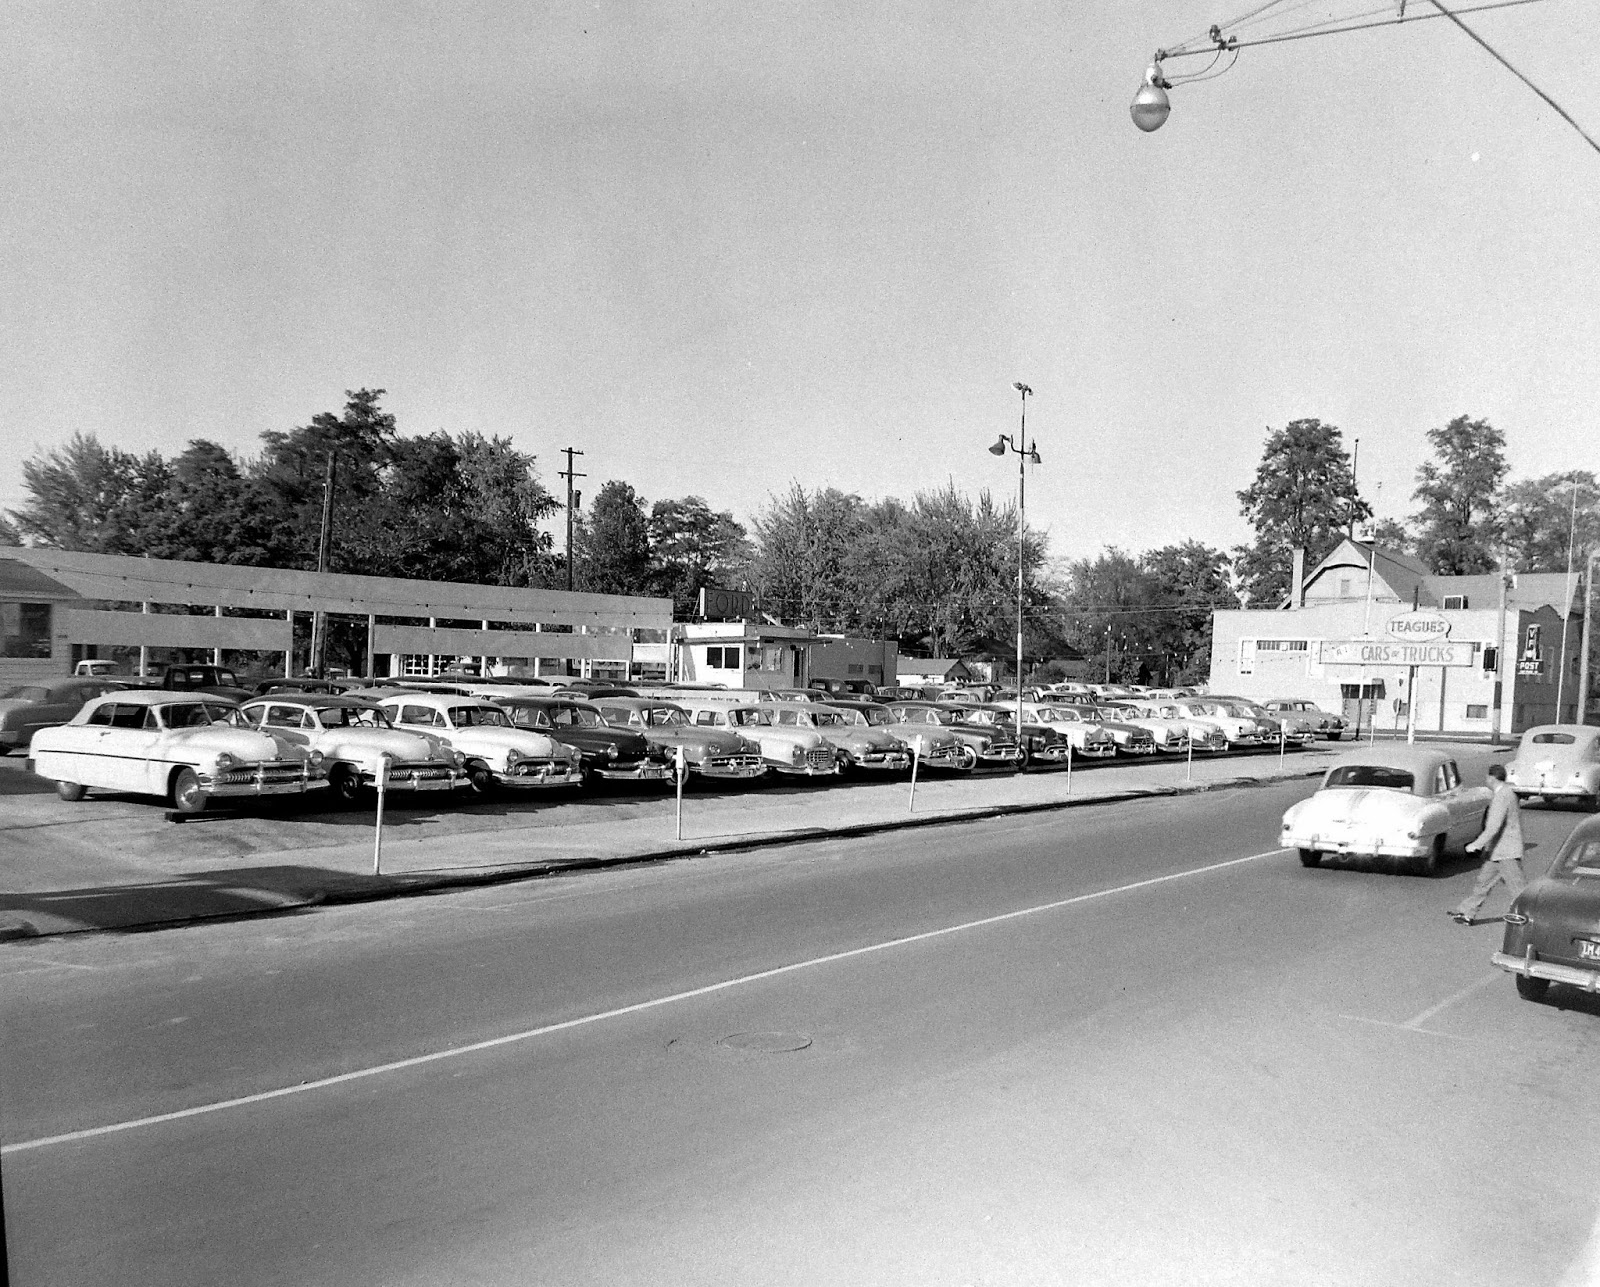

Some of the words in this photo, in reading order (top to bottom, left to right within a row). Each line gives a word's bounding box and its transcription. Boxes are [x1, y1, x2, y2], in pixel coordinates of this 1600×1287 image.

[706, 593, 750, 615] FORD
[1391, 621, 1445, 633] TEAGUES
[1361, 645, 1390, 661] CARS
[1402, 646, 1454, 662] TRUCKS
[1520, 661, 1539, 670] POST
